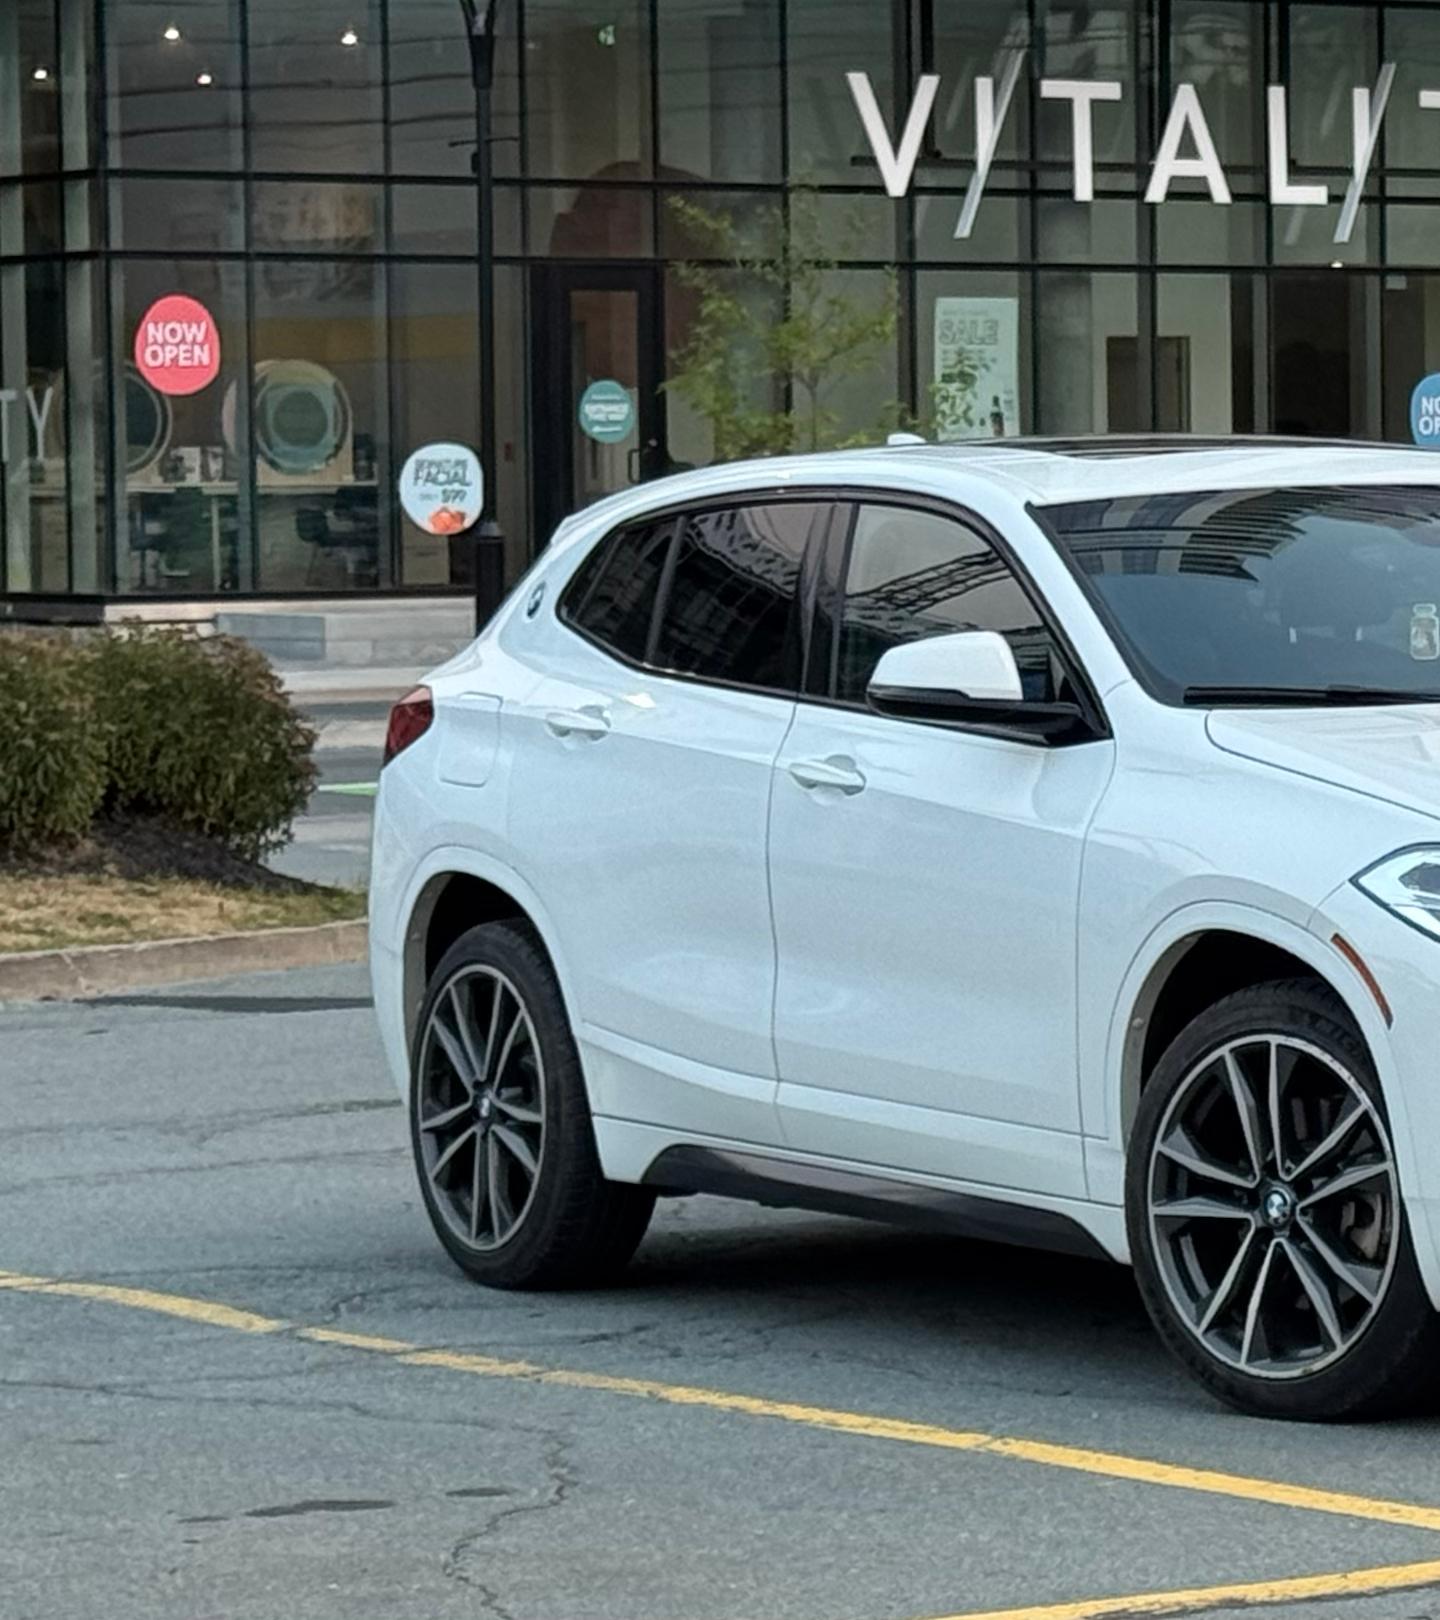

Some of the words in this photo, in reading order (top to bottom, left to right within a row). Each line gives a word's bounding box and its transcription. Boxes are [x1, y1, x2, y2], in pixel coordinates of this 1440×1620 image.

[146, 321, 207, 344] NOW
[939, 319, 999, 346] SALE
[144, 343, 210, 368] OPEN
[413, 467, 473, 487] FACIAL
